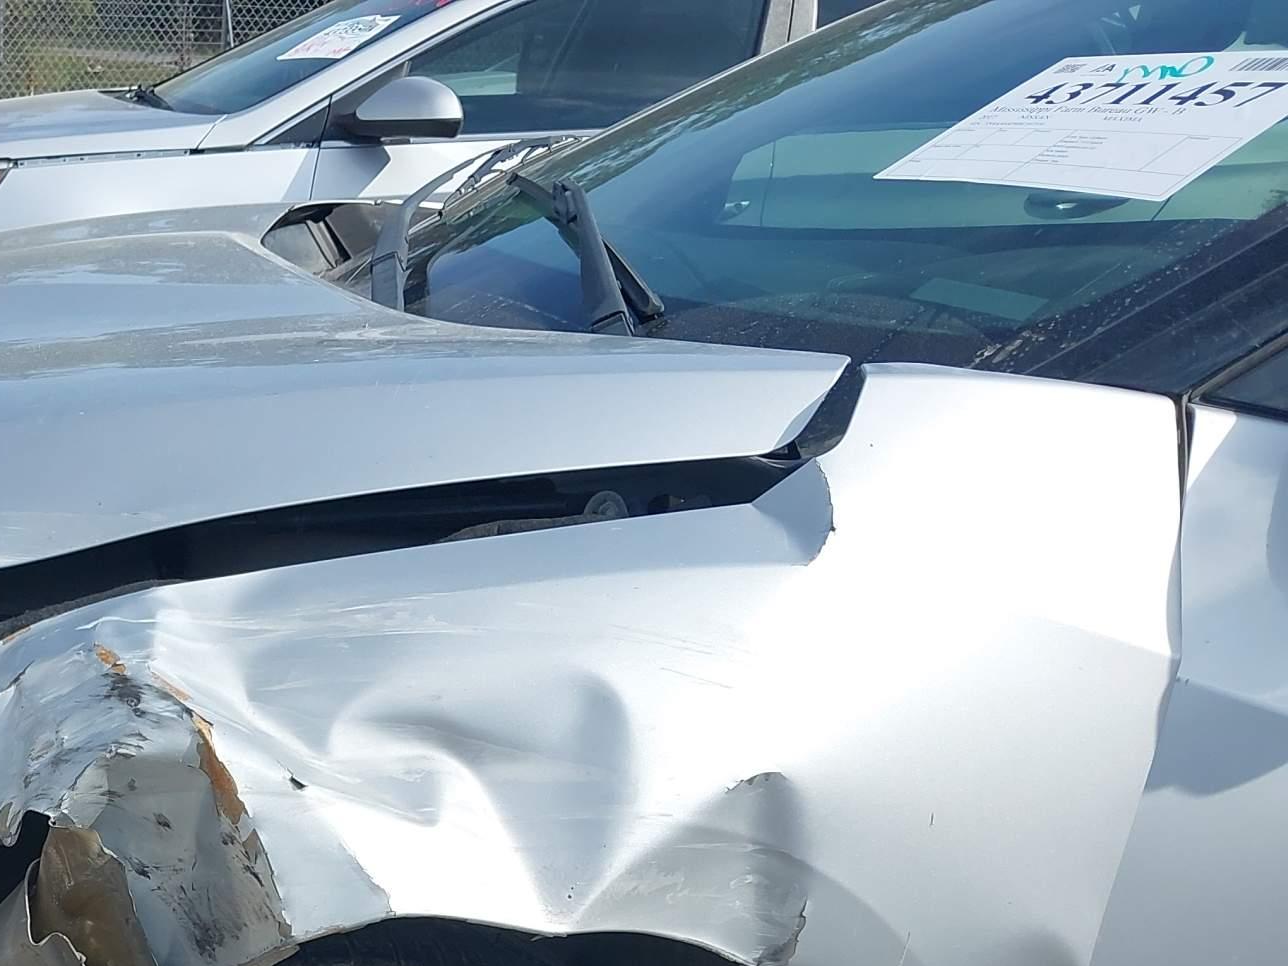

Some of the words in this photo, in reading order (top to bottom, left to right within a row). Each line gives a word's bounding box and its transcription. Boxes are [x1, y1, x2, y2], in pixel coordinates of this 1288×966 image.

[1024, 81, 1288, 108] 43711457
[991, 106, 1052, 114] Mississippi
[1052, 106, 1086, 114] Farm
[1087, 106, 1133, 114] Bureau
